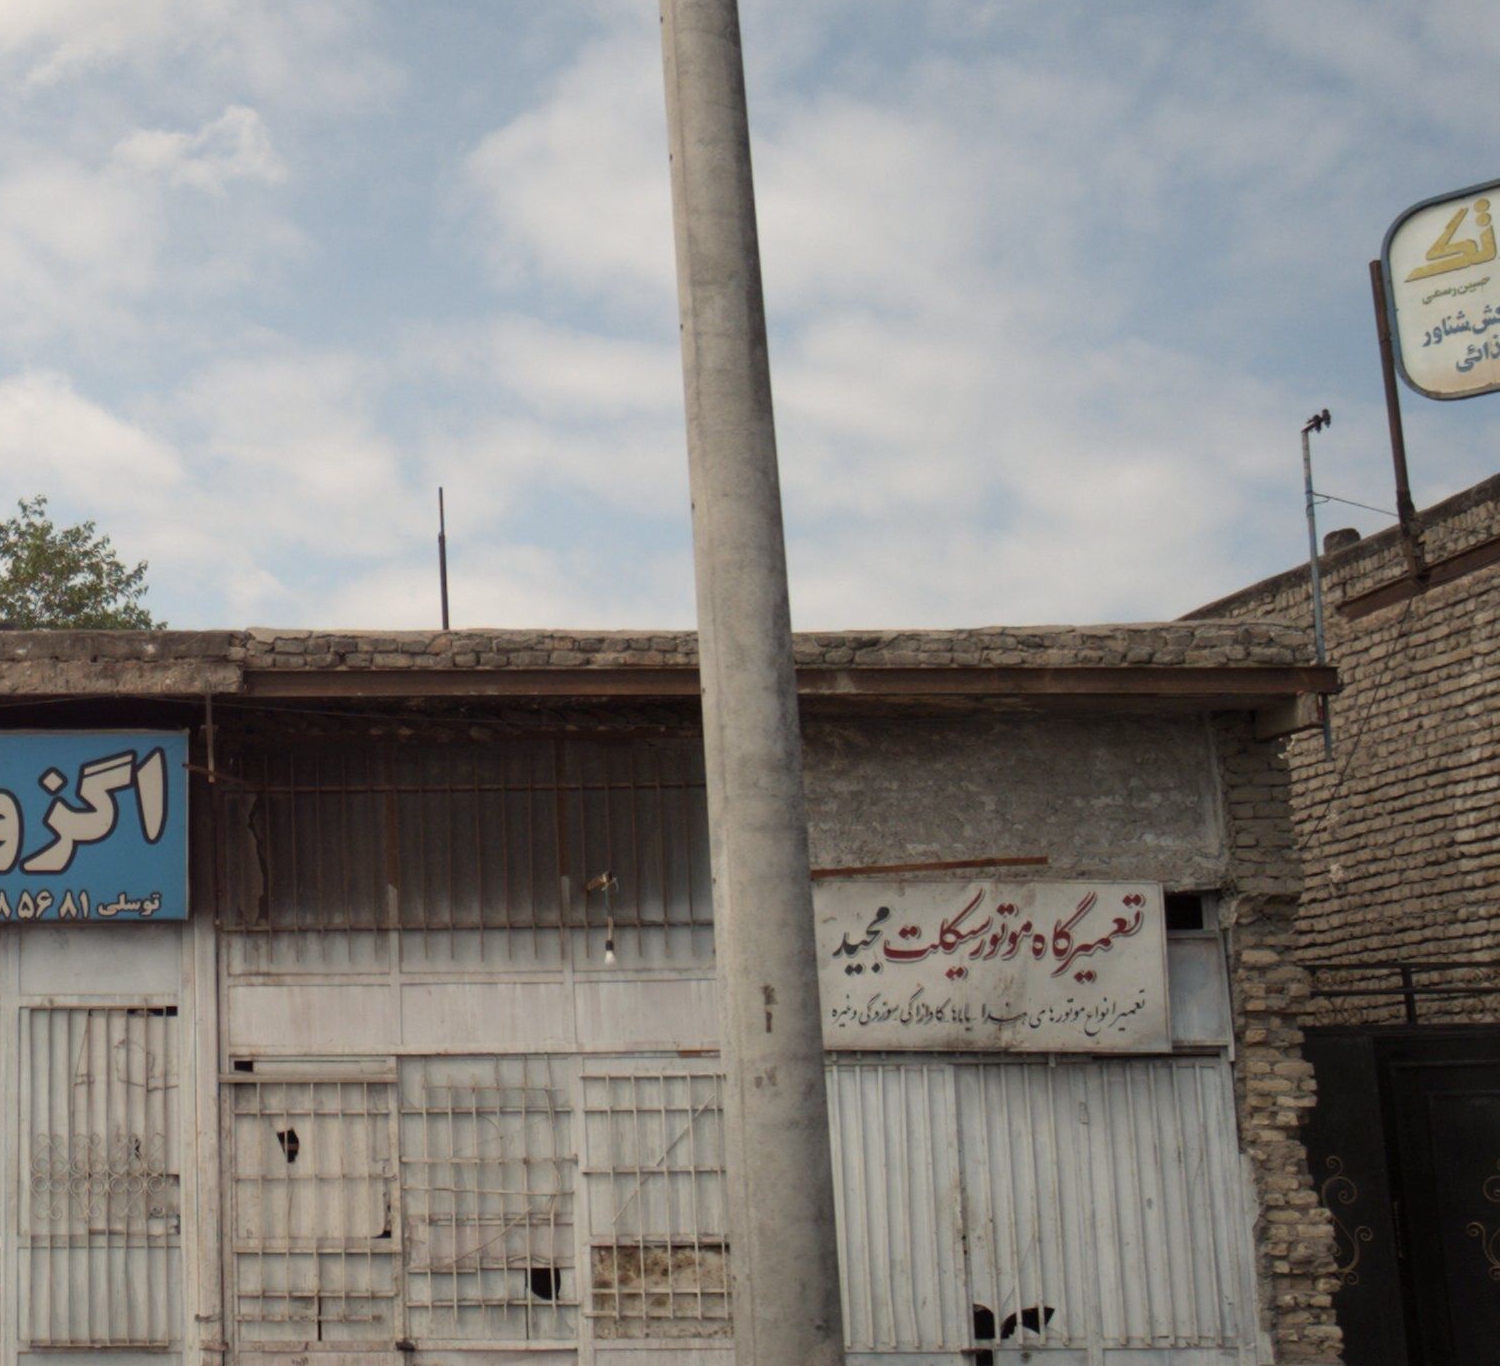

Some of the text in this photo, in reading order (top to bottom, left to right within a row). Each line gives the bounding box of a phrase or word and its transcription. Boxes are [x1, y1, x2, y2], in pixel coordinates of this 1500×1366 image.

[1422, 310, 1471, 348] شناور
[16, 888, 54, 920] ۵۶
[58, 888, 91, 920] ۸۱
[96, 891, 162, 917] توسلی
[832, 906, 891, 974] مجید
[1031, 891, 1147, 983] تعمیرگاه
[1084, 997, 1117, 1037] انواع
[1109, 989, 1146, 1032] تعمیر
